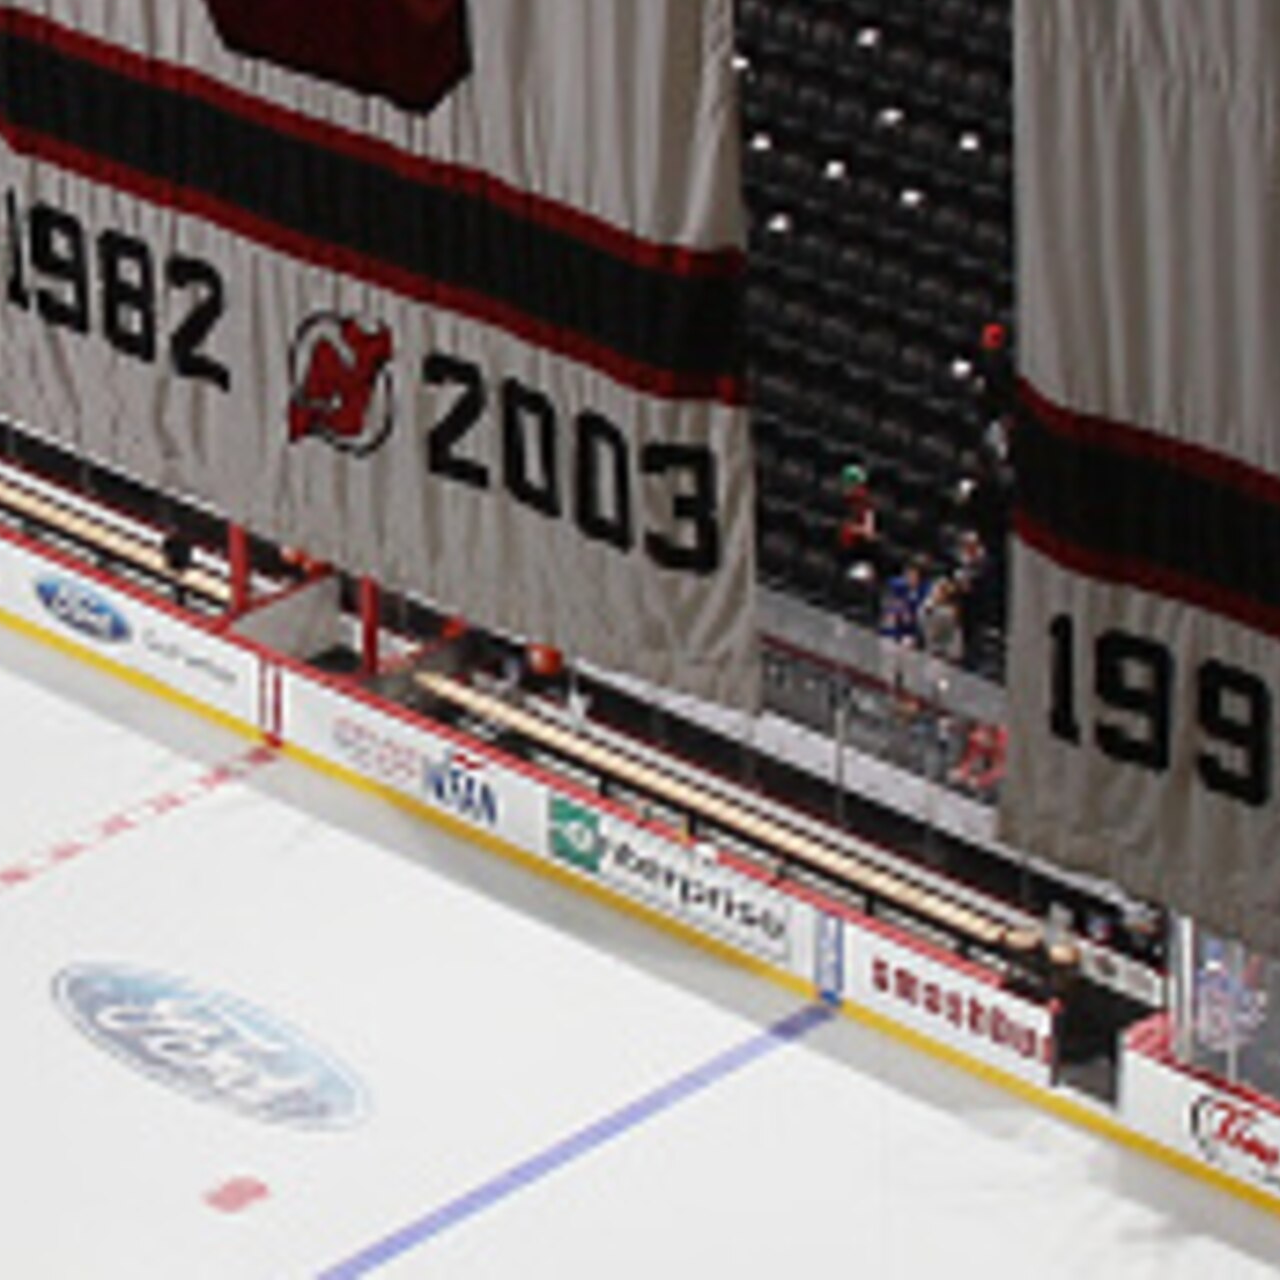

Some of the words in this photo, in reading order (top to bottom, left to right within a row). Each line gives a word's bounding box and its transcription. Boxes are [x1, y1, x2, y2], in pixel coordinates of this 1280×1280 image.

[4, 188, 231, 391] 1982
[423, 351, 721, 575] 2003
[1208, 1100, 1280, 1167] Tim
